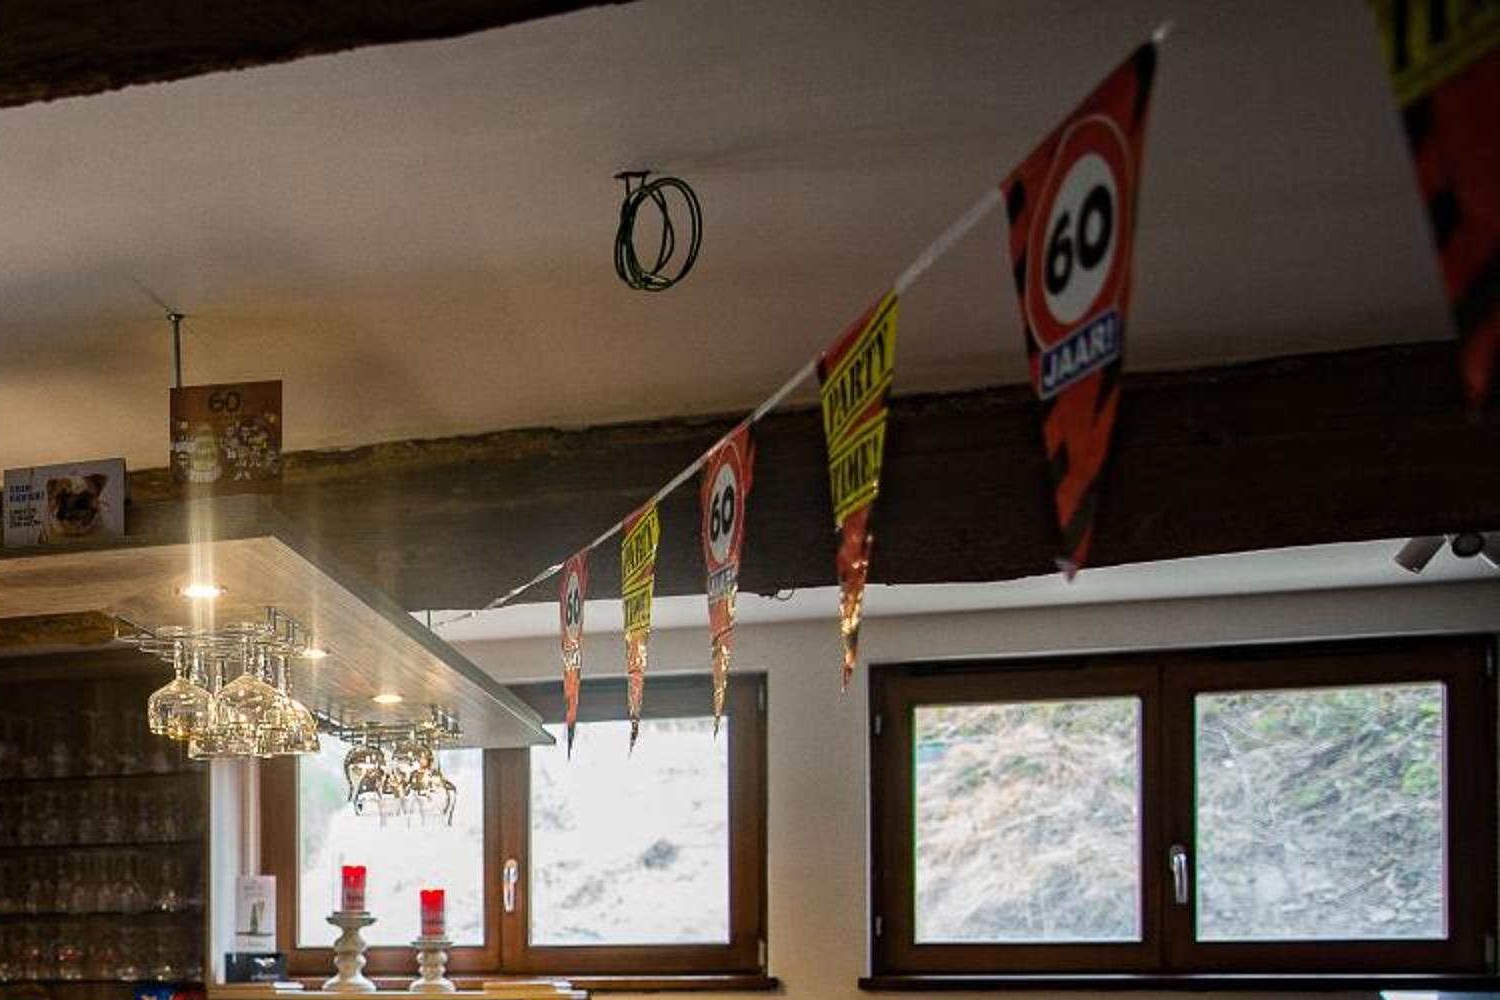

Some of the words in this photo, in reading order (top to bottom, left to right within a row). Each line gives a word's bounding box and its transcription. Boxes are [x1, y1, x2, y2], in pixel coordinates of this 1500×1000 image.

[1045, 185, 1114, 296] 60
[827, 321, 888, 433] PARTY
[1042, 317, 1115, 390] JAAR!
[209, 391, 242, 413] 60
[832, 434, 879, 508] TIME!
[710, 486, 735, 543] 60
[566, 588, 581, 626] 60
